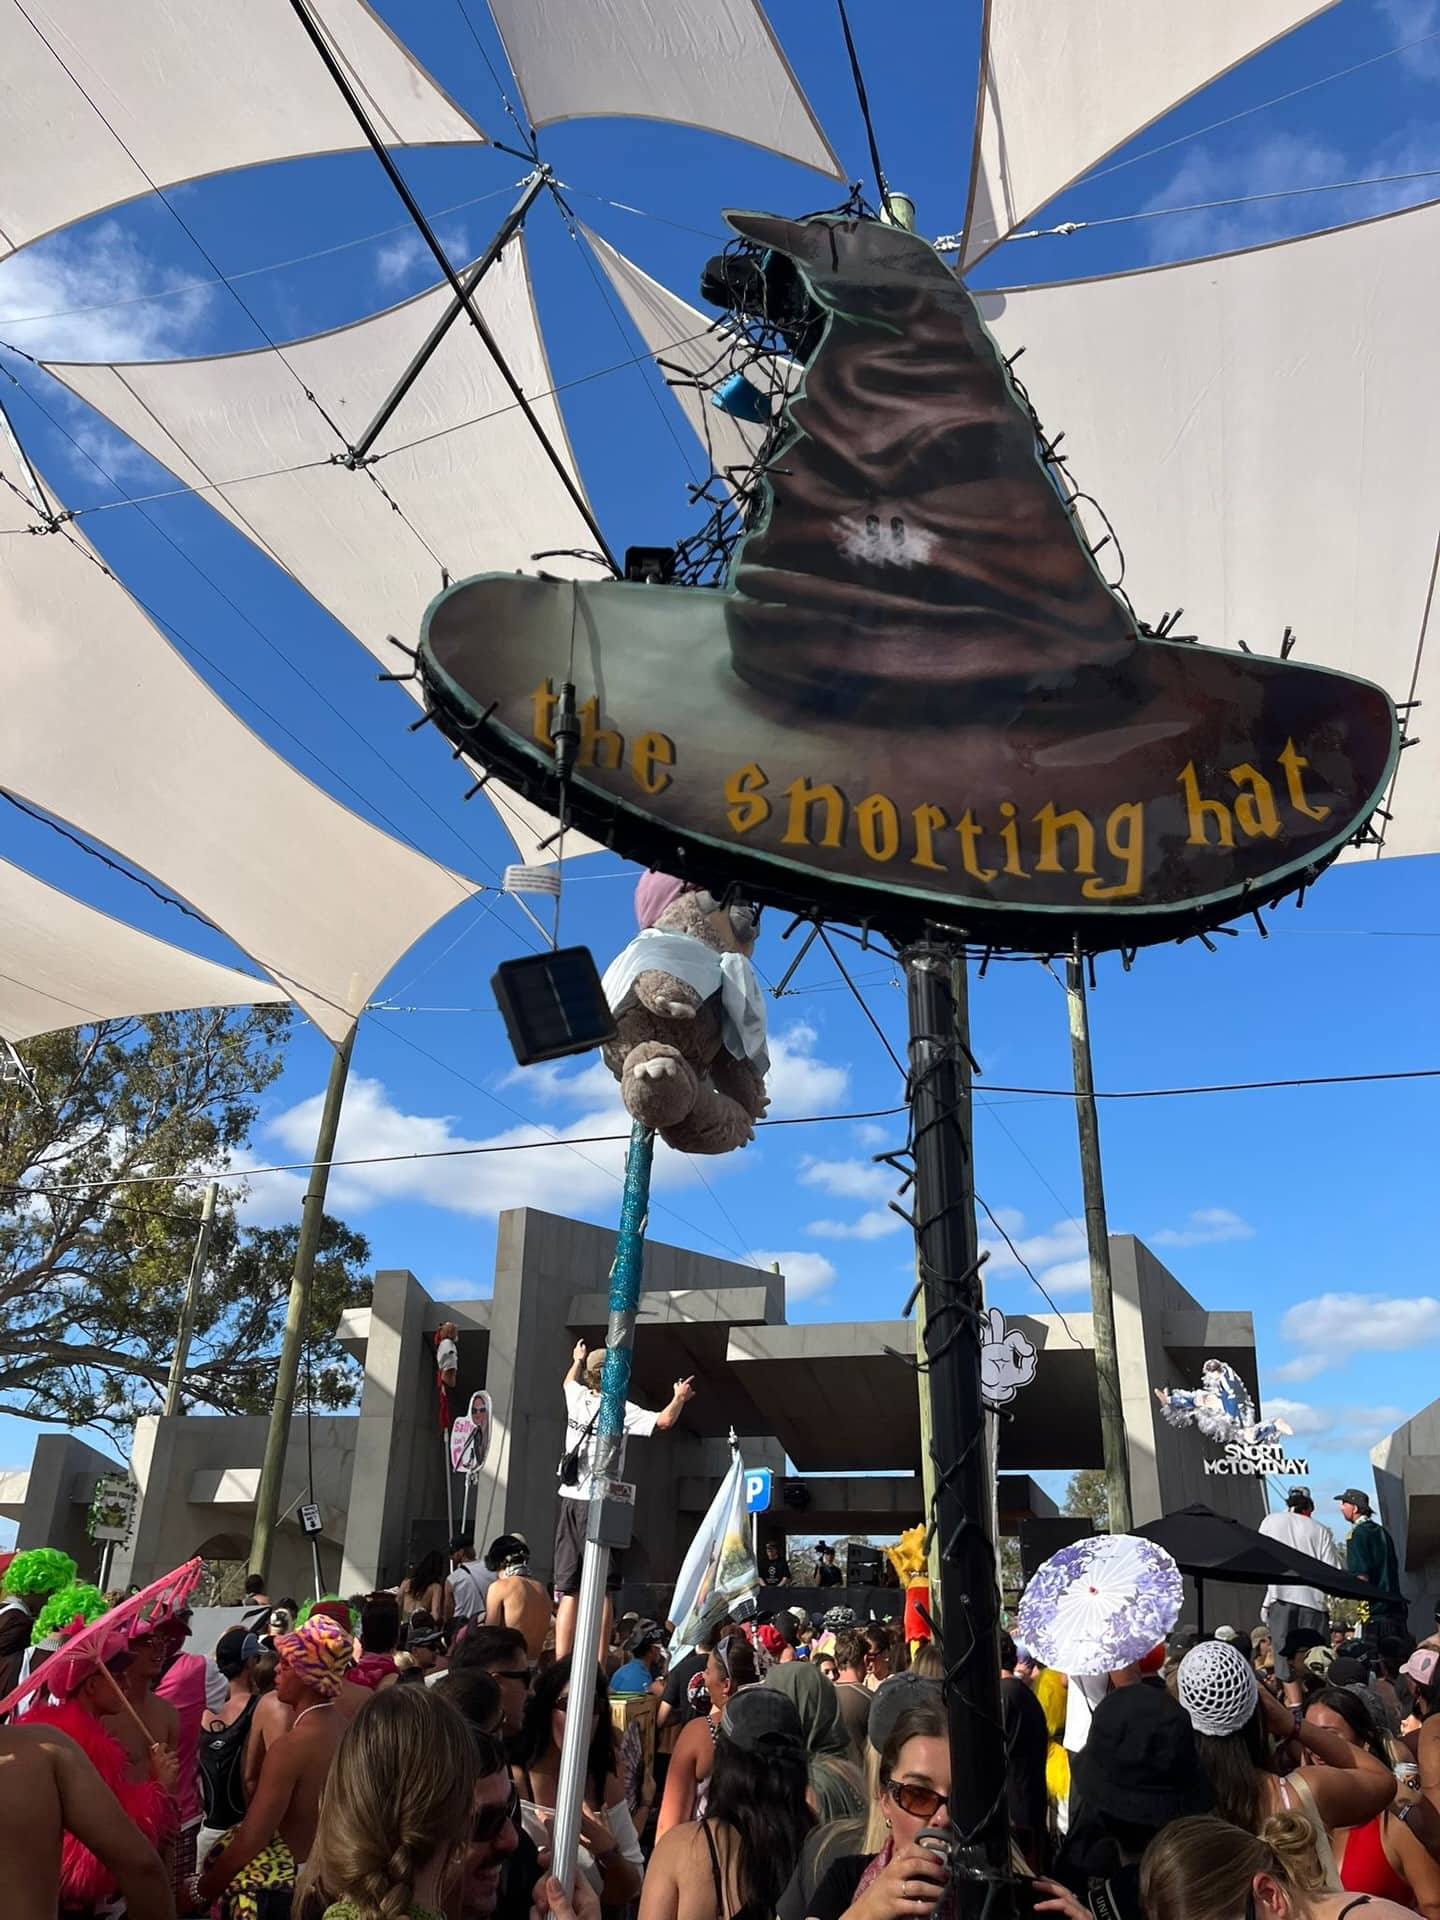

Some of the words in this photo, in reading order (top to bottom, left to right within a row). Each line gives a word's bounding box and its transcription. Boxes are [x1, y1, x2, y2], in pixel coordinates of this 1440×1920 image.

[531, 678, 676, 795] the
[725, 763, 1145, 898] snorting
[1176, 735, 1331, 848] hat
[1224, 1444, 1283, 1460] SNORT
[1203, 1459, 1309, 1475] MCTOMINAY
[746, 1477, 763, 1503] P
